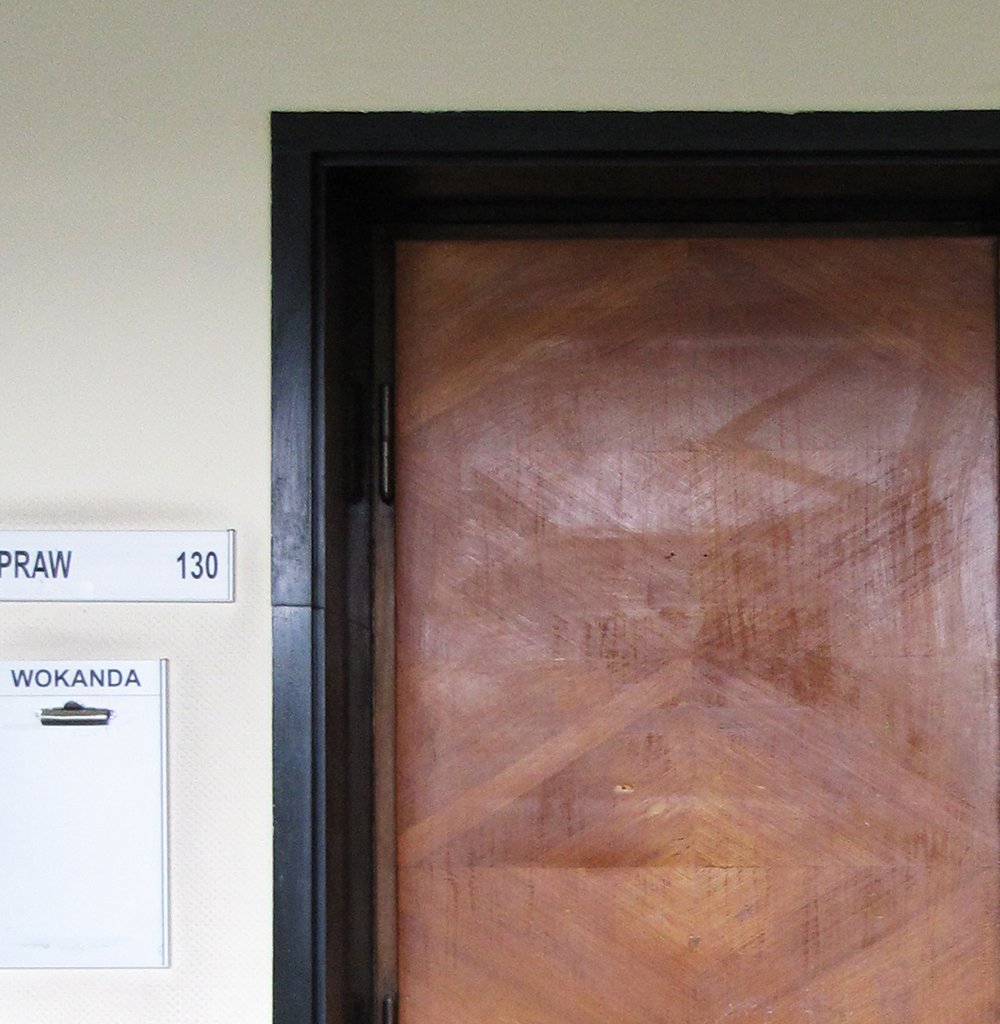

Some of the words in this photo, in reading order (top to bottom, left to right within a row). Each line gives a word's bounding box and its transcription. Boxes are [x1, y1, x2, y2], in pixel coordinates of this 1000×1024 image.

[0, 550, 72, 578] PRAW
[177, 551, 218, 579] 130
[11, 669, 141, 687] WOKANDA
